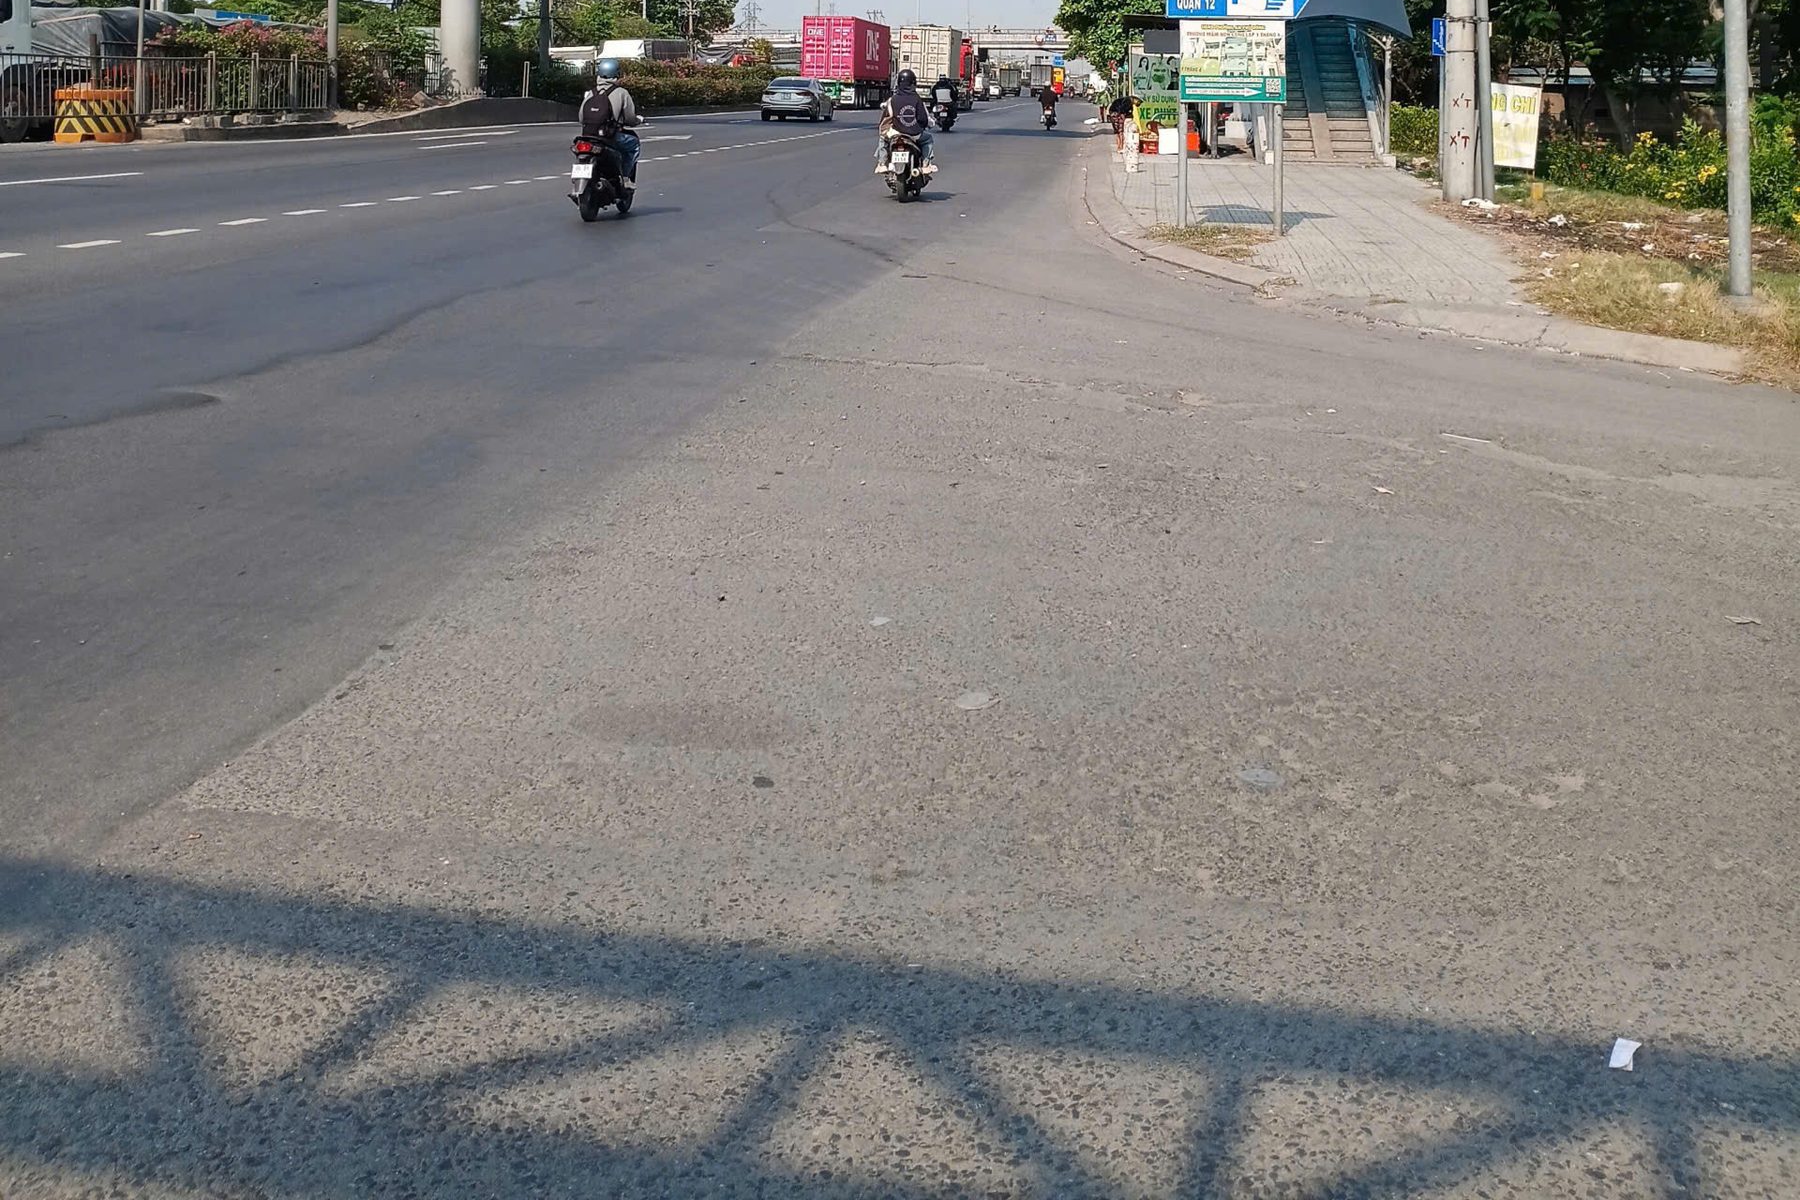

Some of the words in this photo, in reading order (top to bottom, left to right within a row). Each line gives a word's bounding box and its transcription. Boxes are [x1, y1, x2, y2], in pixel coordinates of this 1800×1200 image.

[807, 28, 825, 37] ONE
[866, 29, 880, 62] ONE
[1139, 107, 1151, 120] XE
